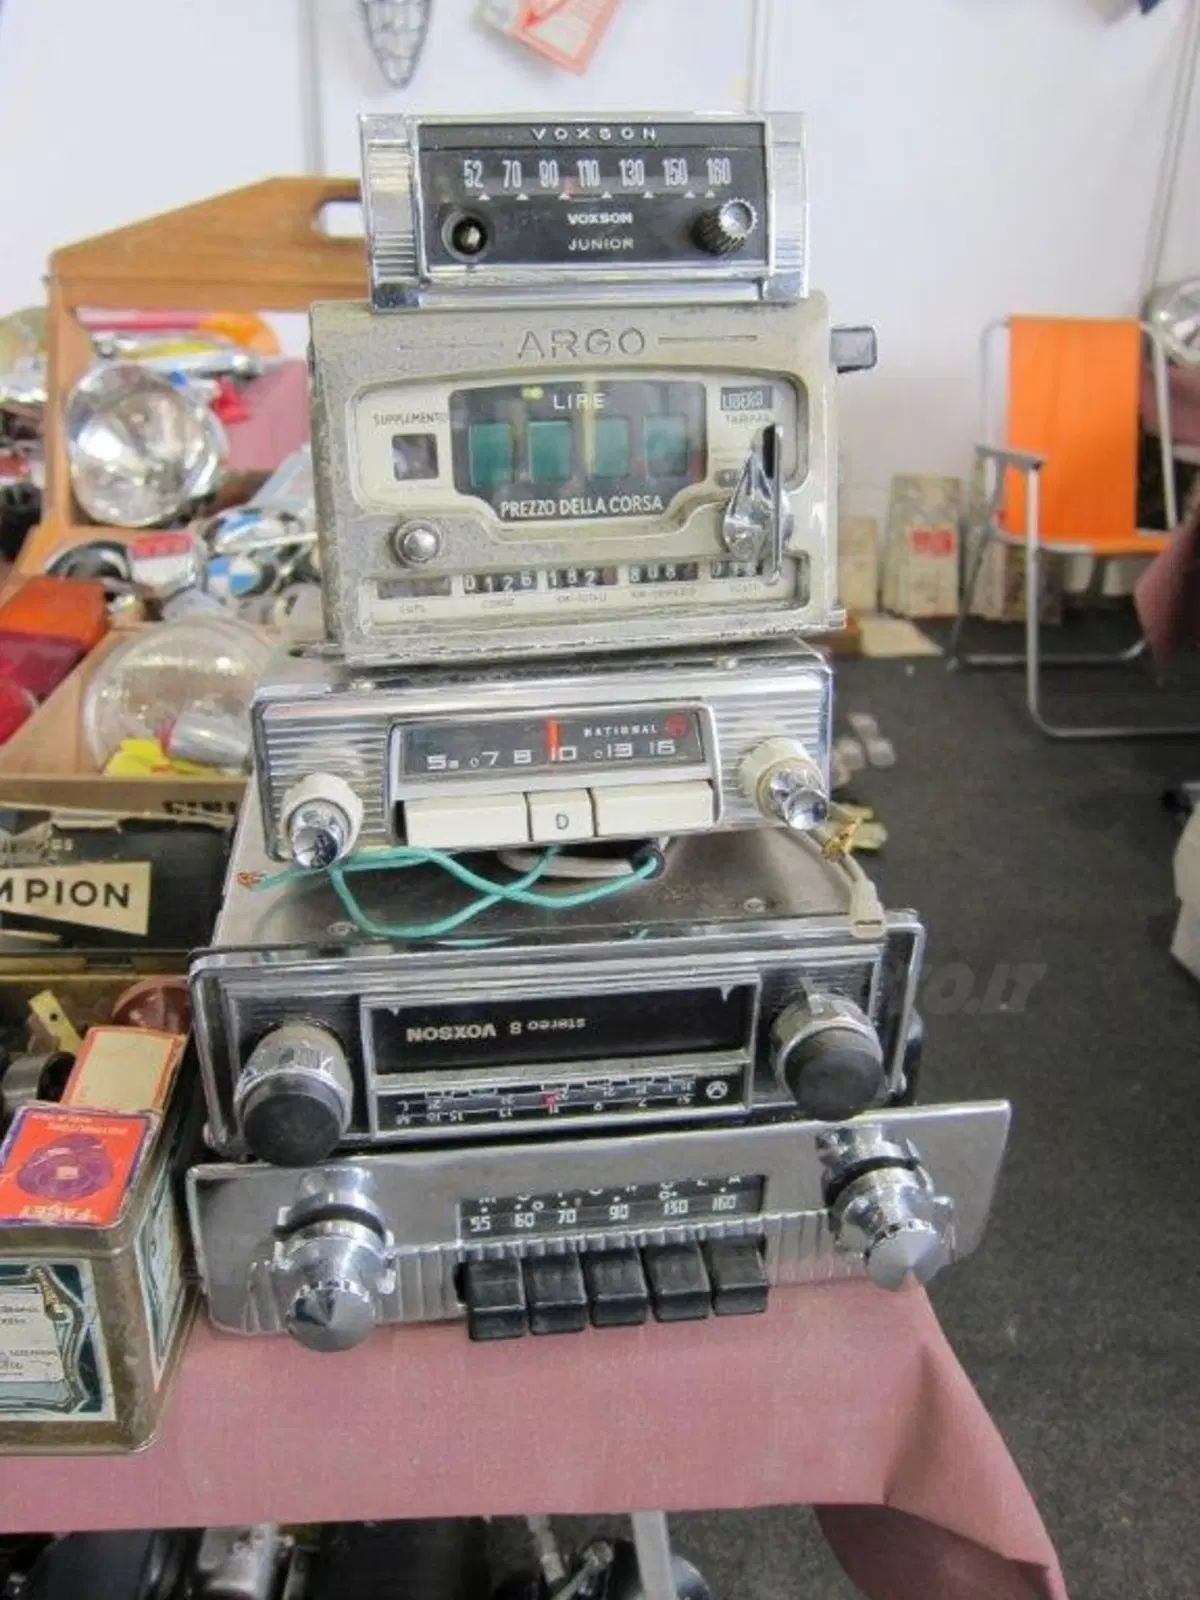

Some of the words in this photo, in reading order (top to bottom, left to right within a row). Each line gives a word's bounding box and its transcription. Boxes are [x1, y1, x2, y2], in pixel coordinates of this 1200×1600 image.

[531, 126, 657, 141] VOXSON
[463, 159, 485, 188] 52
[501, 159, 523, 188] 70
[567, 236, 634, 251] JUNIOR
[517, 327, 646, 360] ARGO
[552, 393, 606, 410] LIRE
[501, 501, 556, 518] PREZZO
[559, 498, 607, 515] DELLA
[608, 495, 664, 513] CORSA
[406, 1023, 497, 1042] VOXSON
